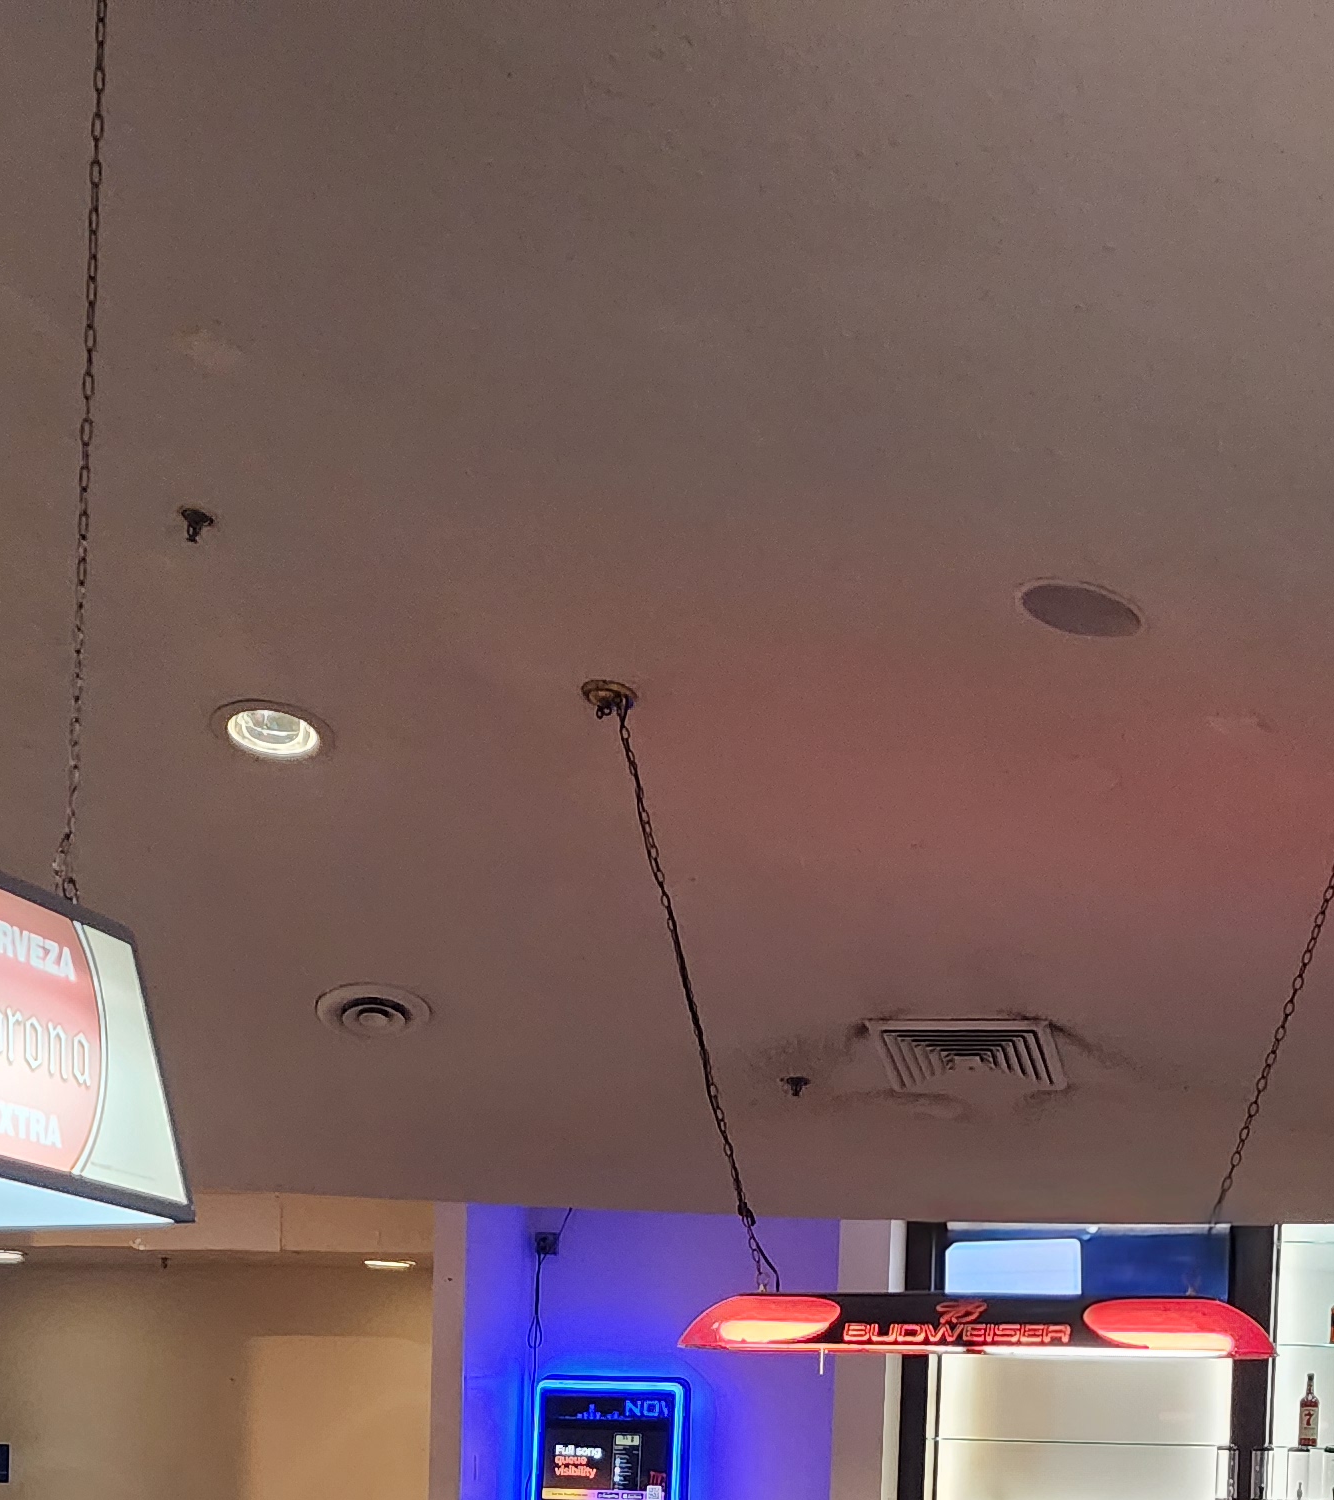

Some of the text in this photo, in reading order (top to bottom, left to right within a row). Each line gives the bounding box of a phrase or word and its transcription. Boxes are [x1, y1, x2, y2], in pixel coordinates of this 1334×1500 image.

[843, 1322, 1071, 1345] BUDWEISER
[1303, 1410, 1315, 1426] 7
[555, 1445, 603, 1459] Full song
[555, 1456, 588, 1466] queue
[555, 1465, 597, 1479] visibility
